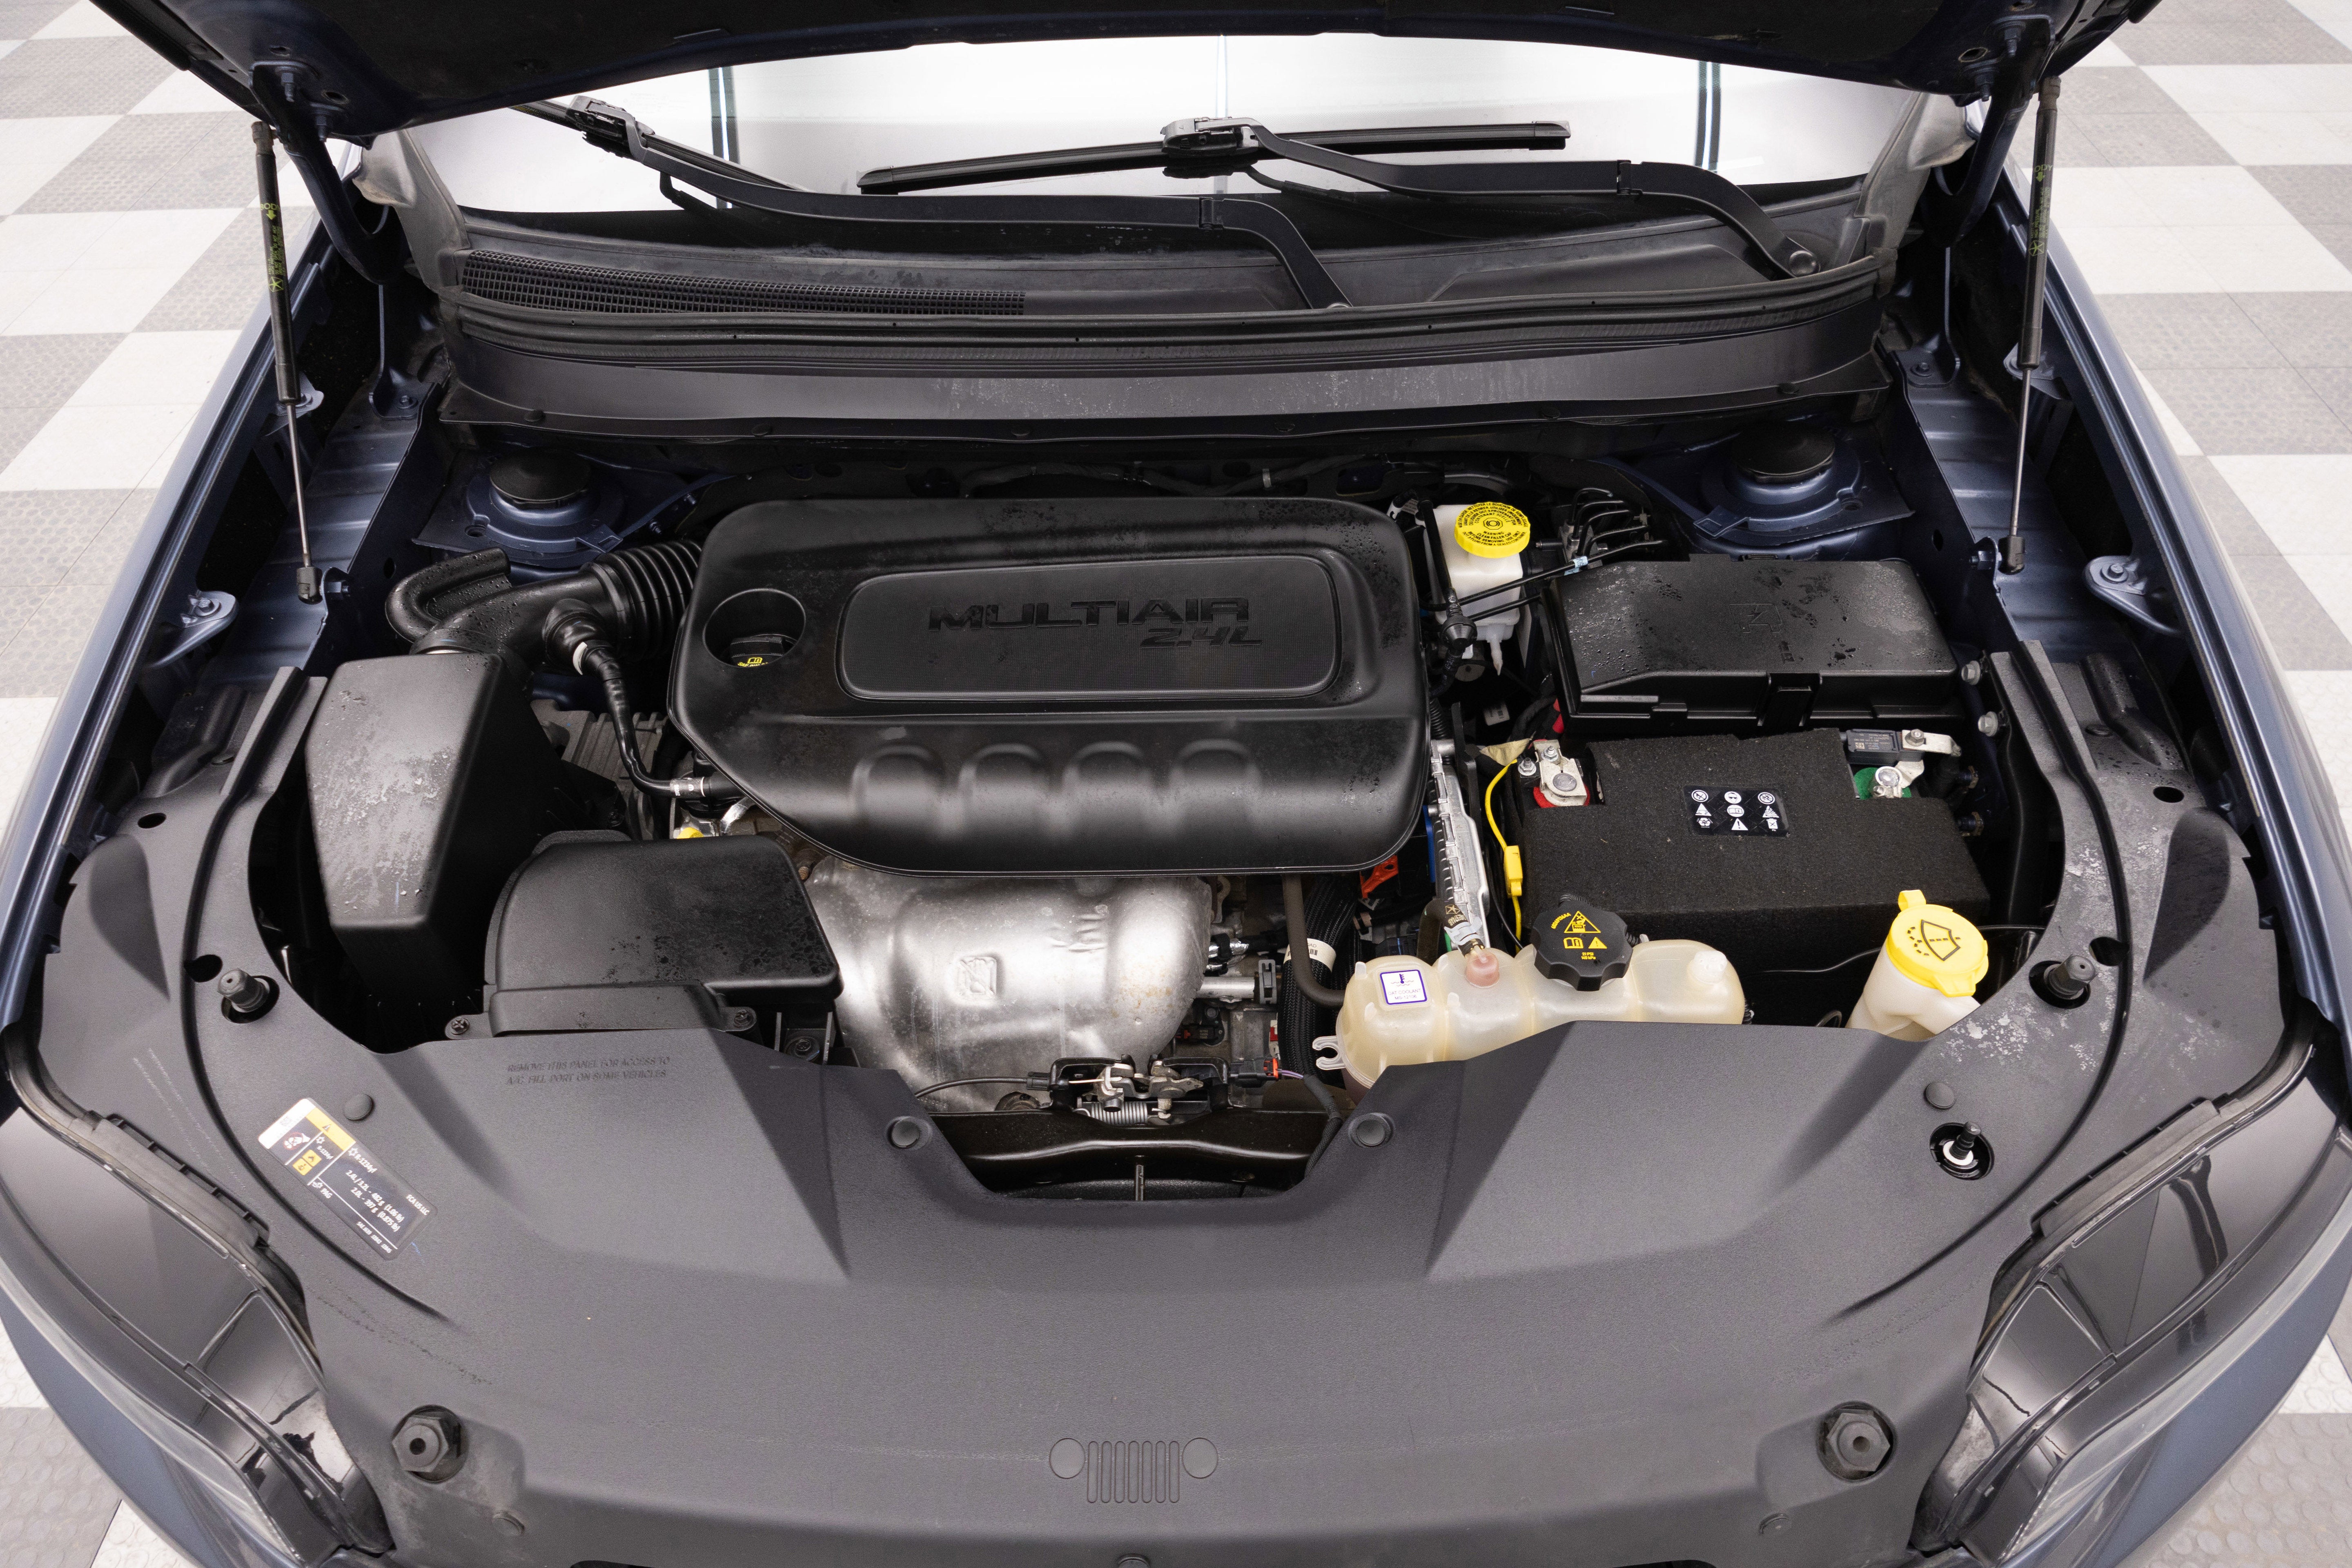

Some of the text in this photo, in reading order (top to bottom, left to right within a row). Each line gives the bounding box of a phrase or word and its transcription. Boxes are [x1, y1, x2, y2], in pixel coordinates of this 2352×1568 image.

[1474, 513, 1495, 523] CONTENANT
[1468, 531, 1481, 540] BEFORE
[928, 597, 1250, 631] MULTIAIR
[1140, 626, 1263, 648] 2.4L
[508, 1063, 544, 1072] REMOVE
[547, 1061, 568, 1071] THIS
[659, 1056, 670, 1065] TO
[528, 1074, 546, 1083] FILL
[549, 1074, 573, 1082] PORT
[577, 1072, 590, 1081] ON
[354, 1154, 378, 1173] R-1234yf
[320, 1188, 333, 1198] PAG
[351, 1187, 363, 1198] 2.0L
[364, 1199, 376, 1209] 397
[406, 1194, 416, 1204] FCA
[419, 1206, 430, 1215] LLC
